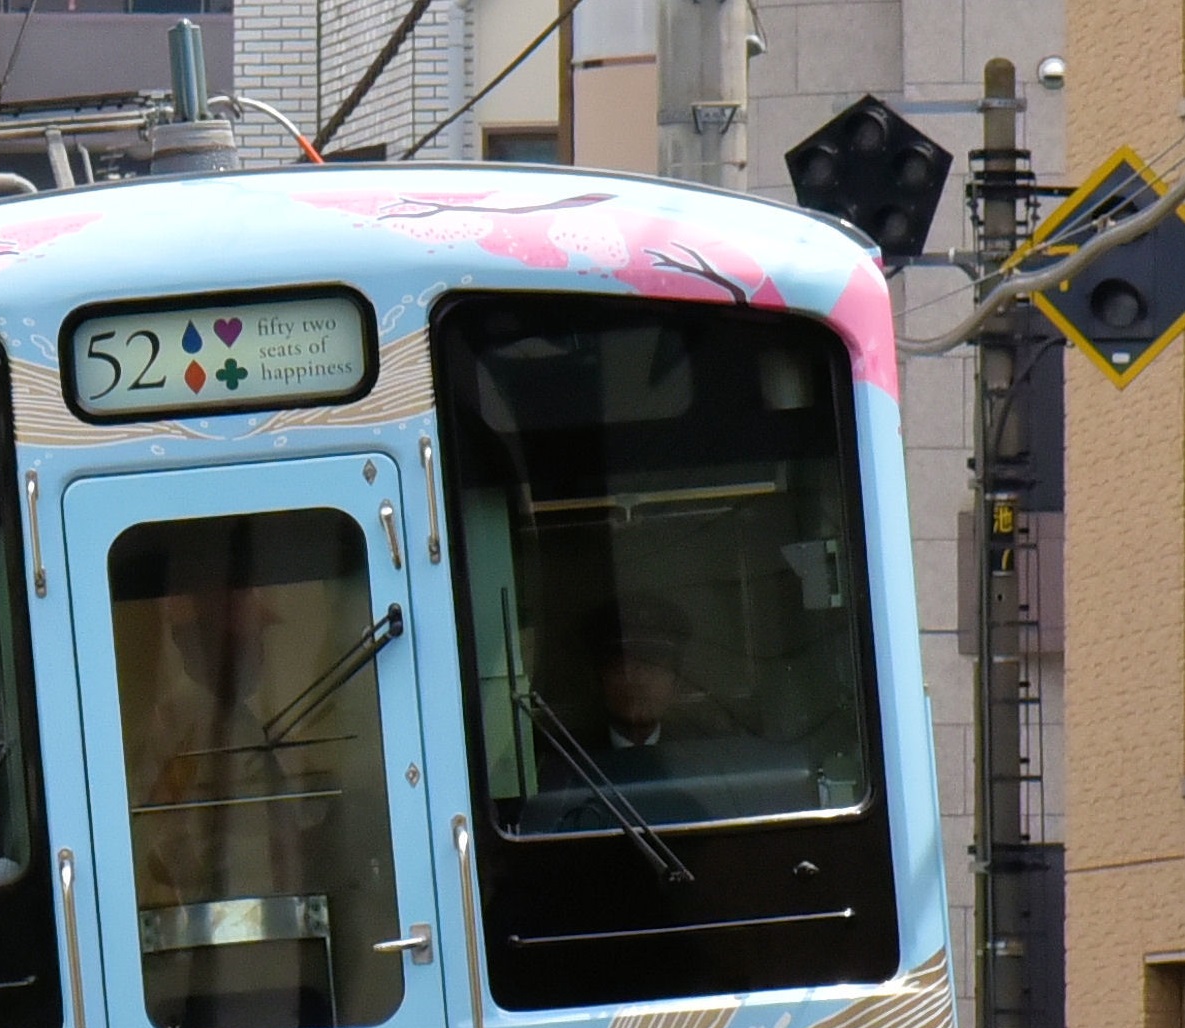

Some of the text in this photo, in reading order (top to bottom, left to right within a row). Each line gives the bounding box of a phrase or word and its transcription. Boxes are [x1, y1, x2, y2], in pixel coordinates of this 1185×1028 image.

[258, 317, 336, 339] fifty two
[259, 335, 329, 358] seats of
[87, 329, 166, 400] 52
[261, 361, 352, 385] happiness
